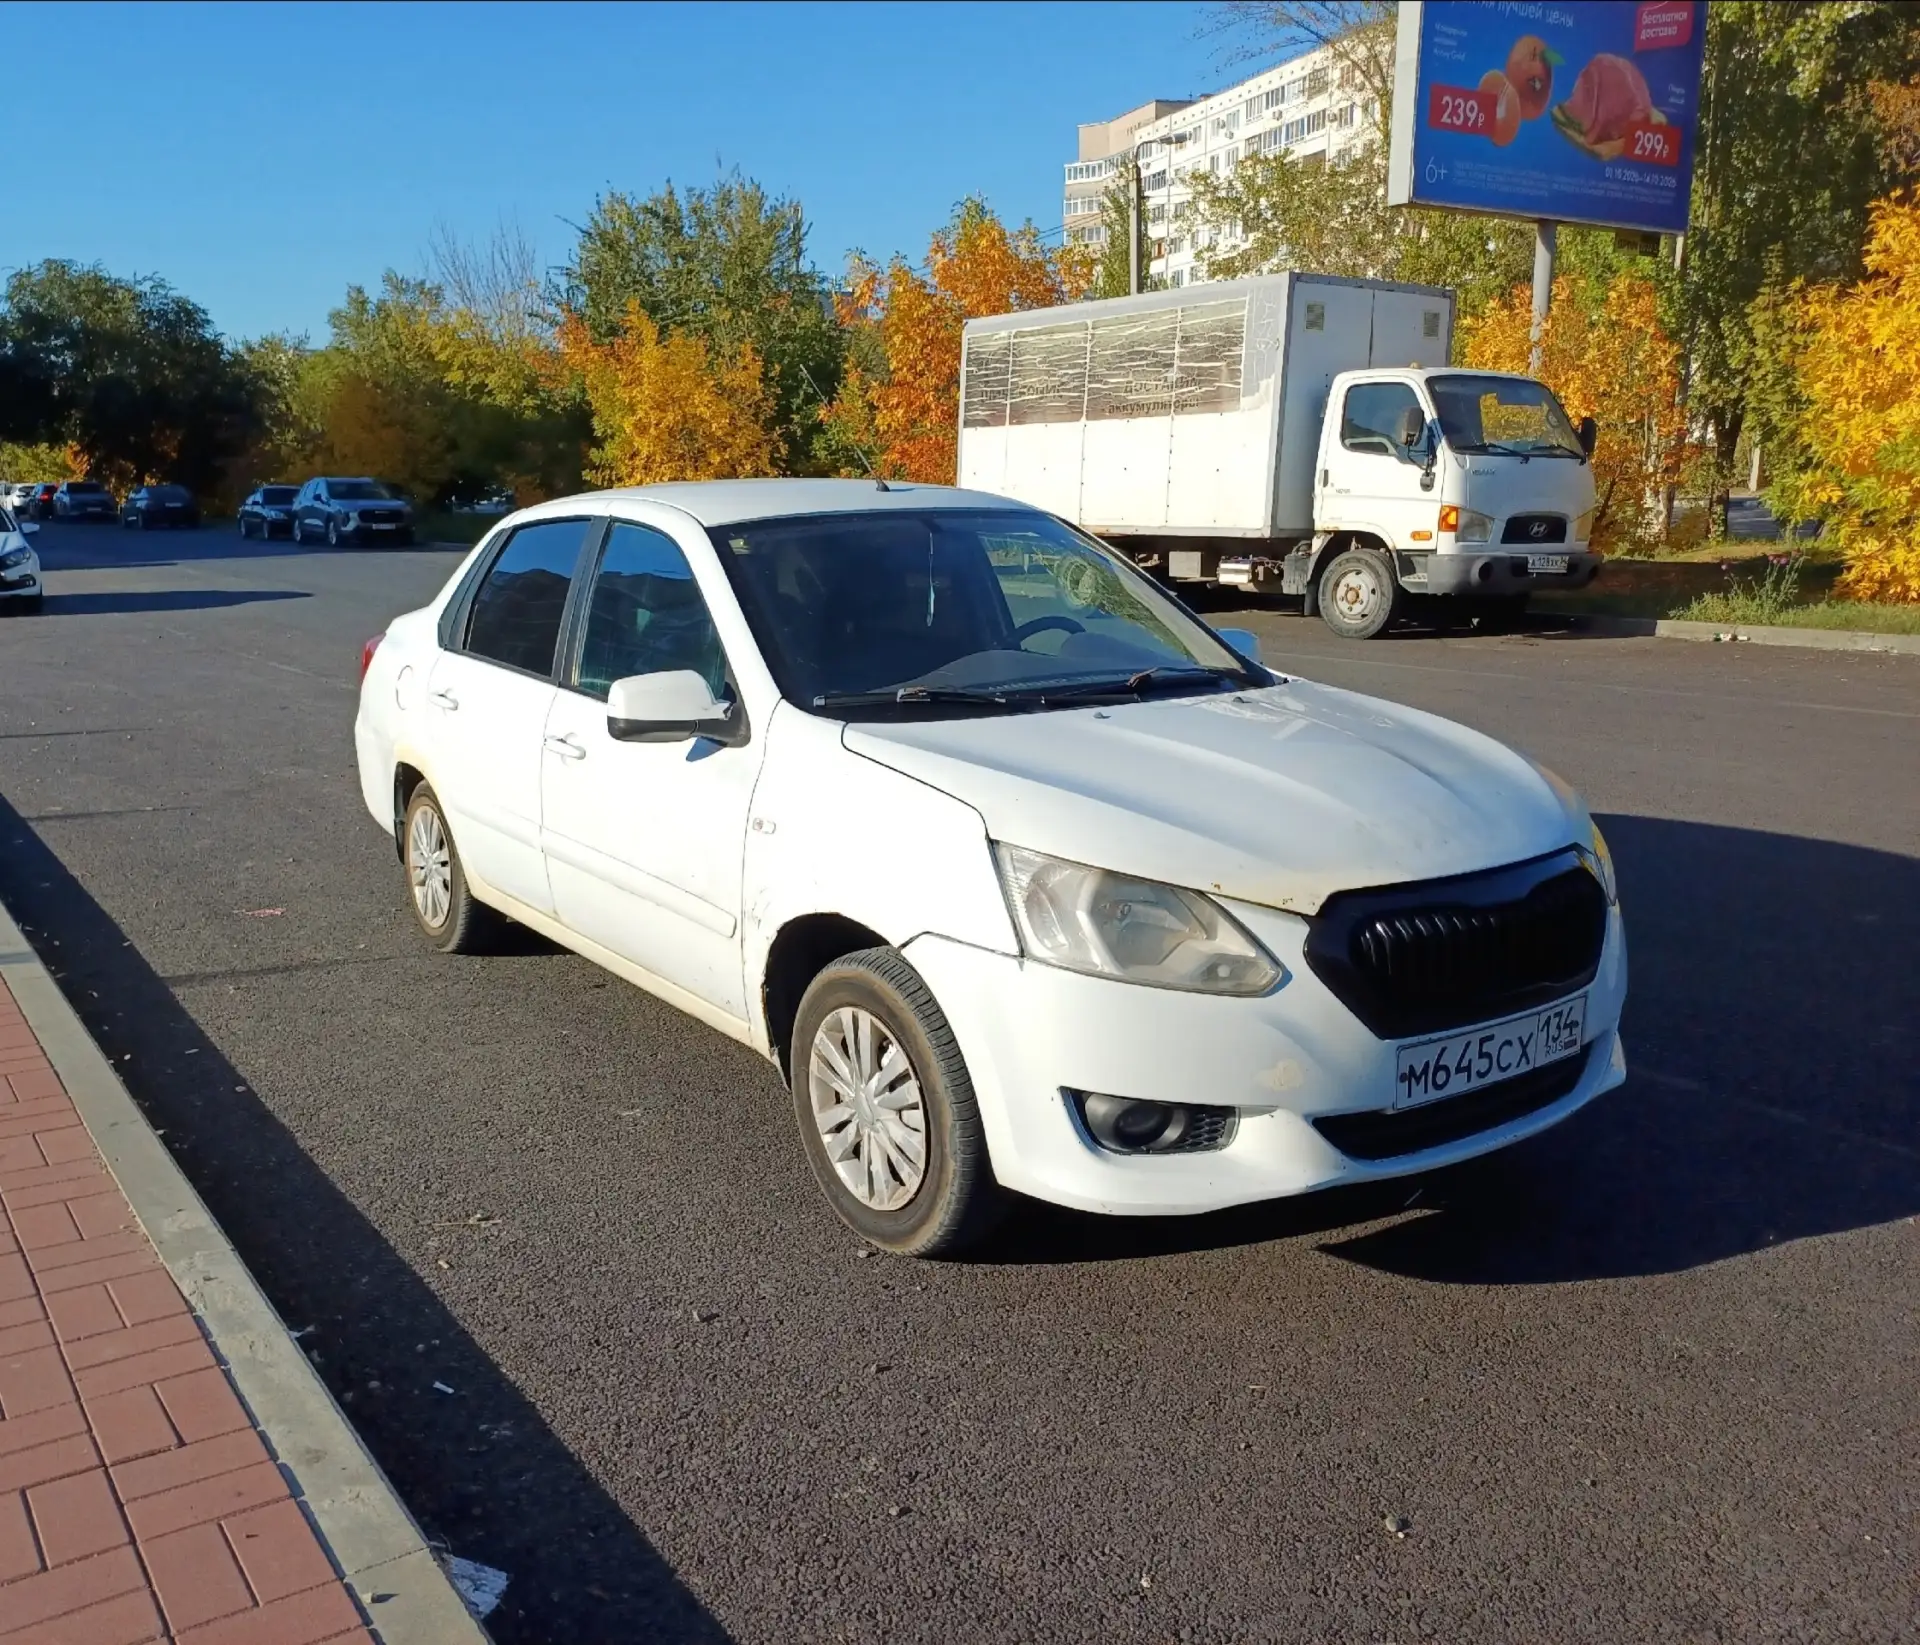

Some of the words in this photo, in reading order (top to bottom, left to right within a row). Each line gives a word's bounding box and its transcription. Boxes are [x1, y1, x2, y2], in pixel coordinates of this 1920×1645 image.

[1546, 9, 1574, 27] цены
[1642, 11, 1688, 25] бесплатная
[1641, 26, 1678, 40] доставка
[1425, 156, 1448, 183] 6+
[1540, 1006, 1576, 1047] 134
[1545, 1040, 1564, 1058] RUS
